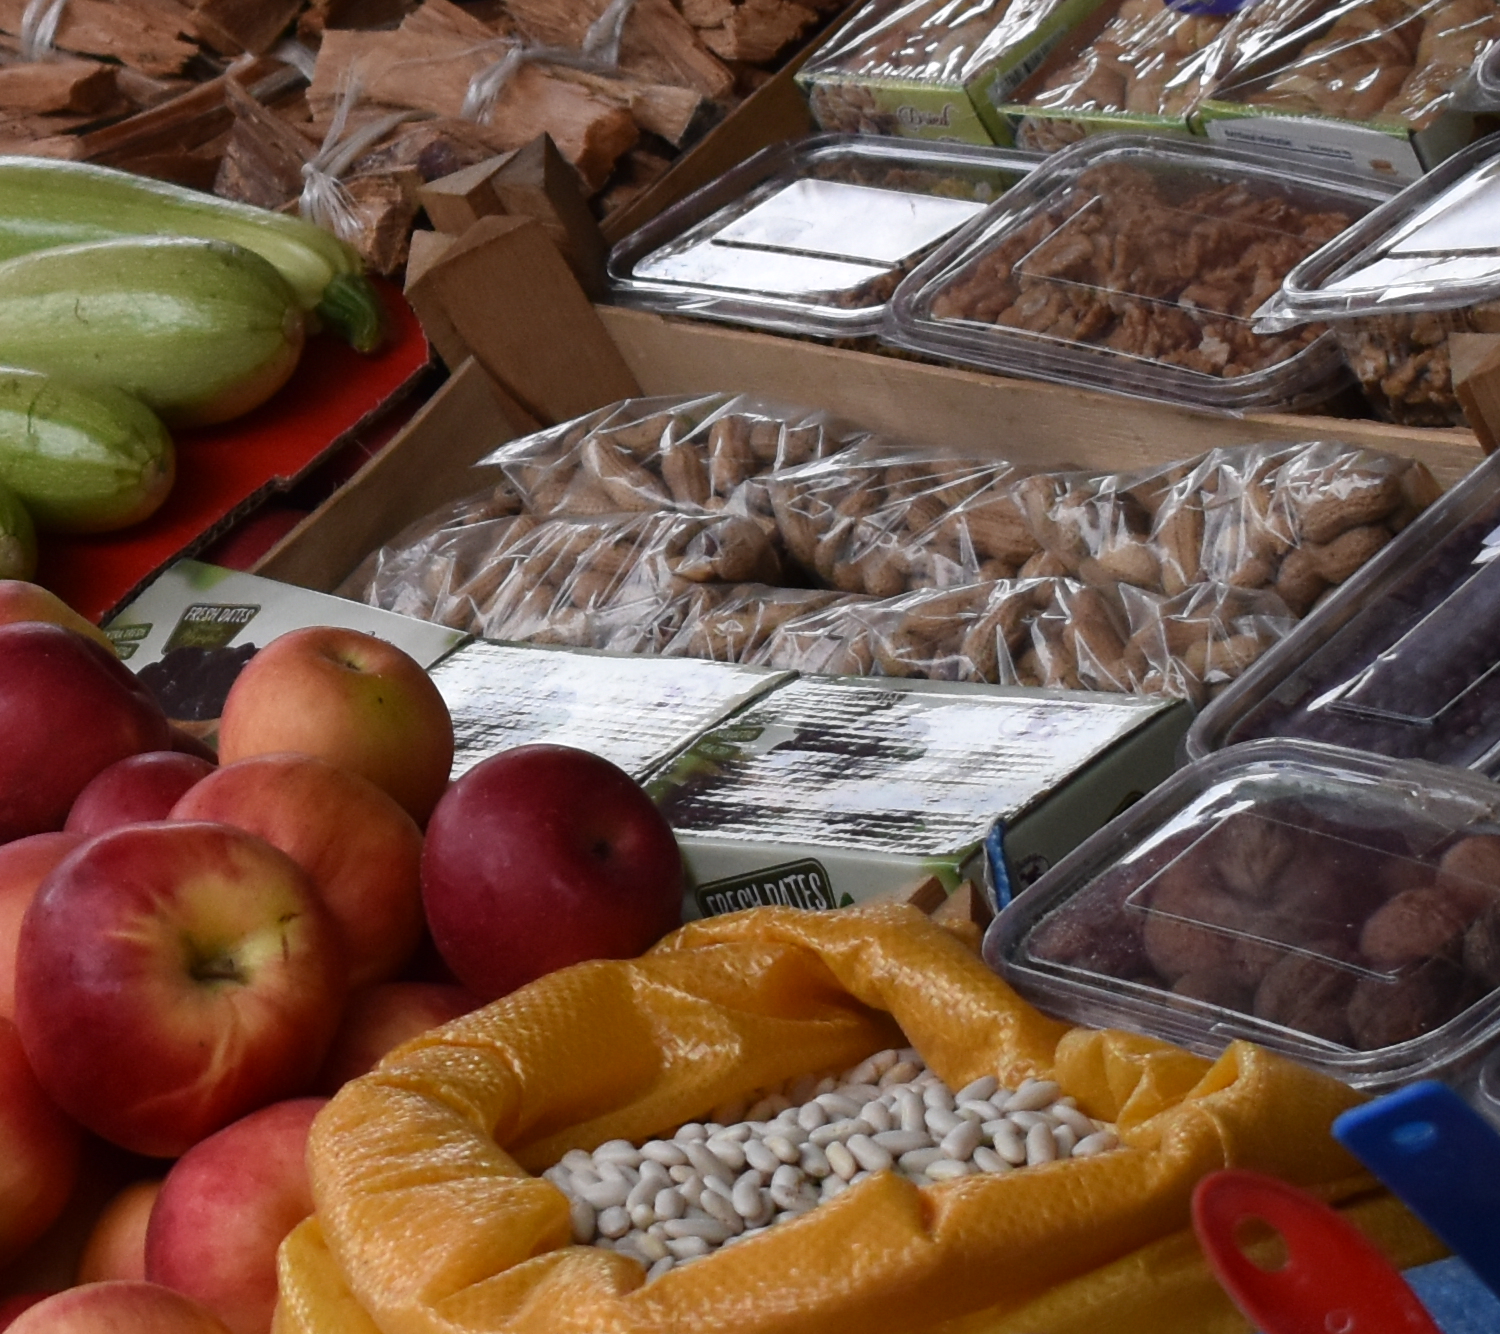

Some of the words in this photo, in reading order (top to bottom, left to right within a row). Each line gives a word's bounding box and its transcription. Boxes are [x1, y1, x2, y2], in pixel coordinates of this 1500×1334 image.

[184, 605, 219, 623] FRESH
[218, 607, 256, 624] DATES
[706, 882, 762, 916] FRESH
[763, 872, 828, 911] DATES
